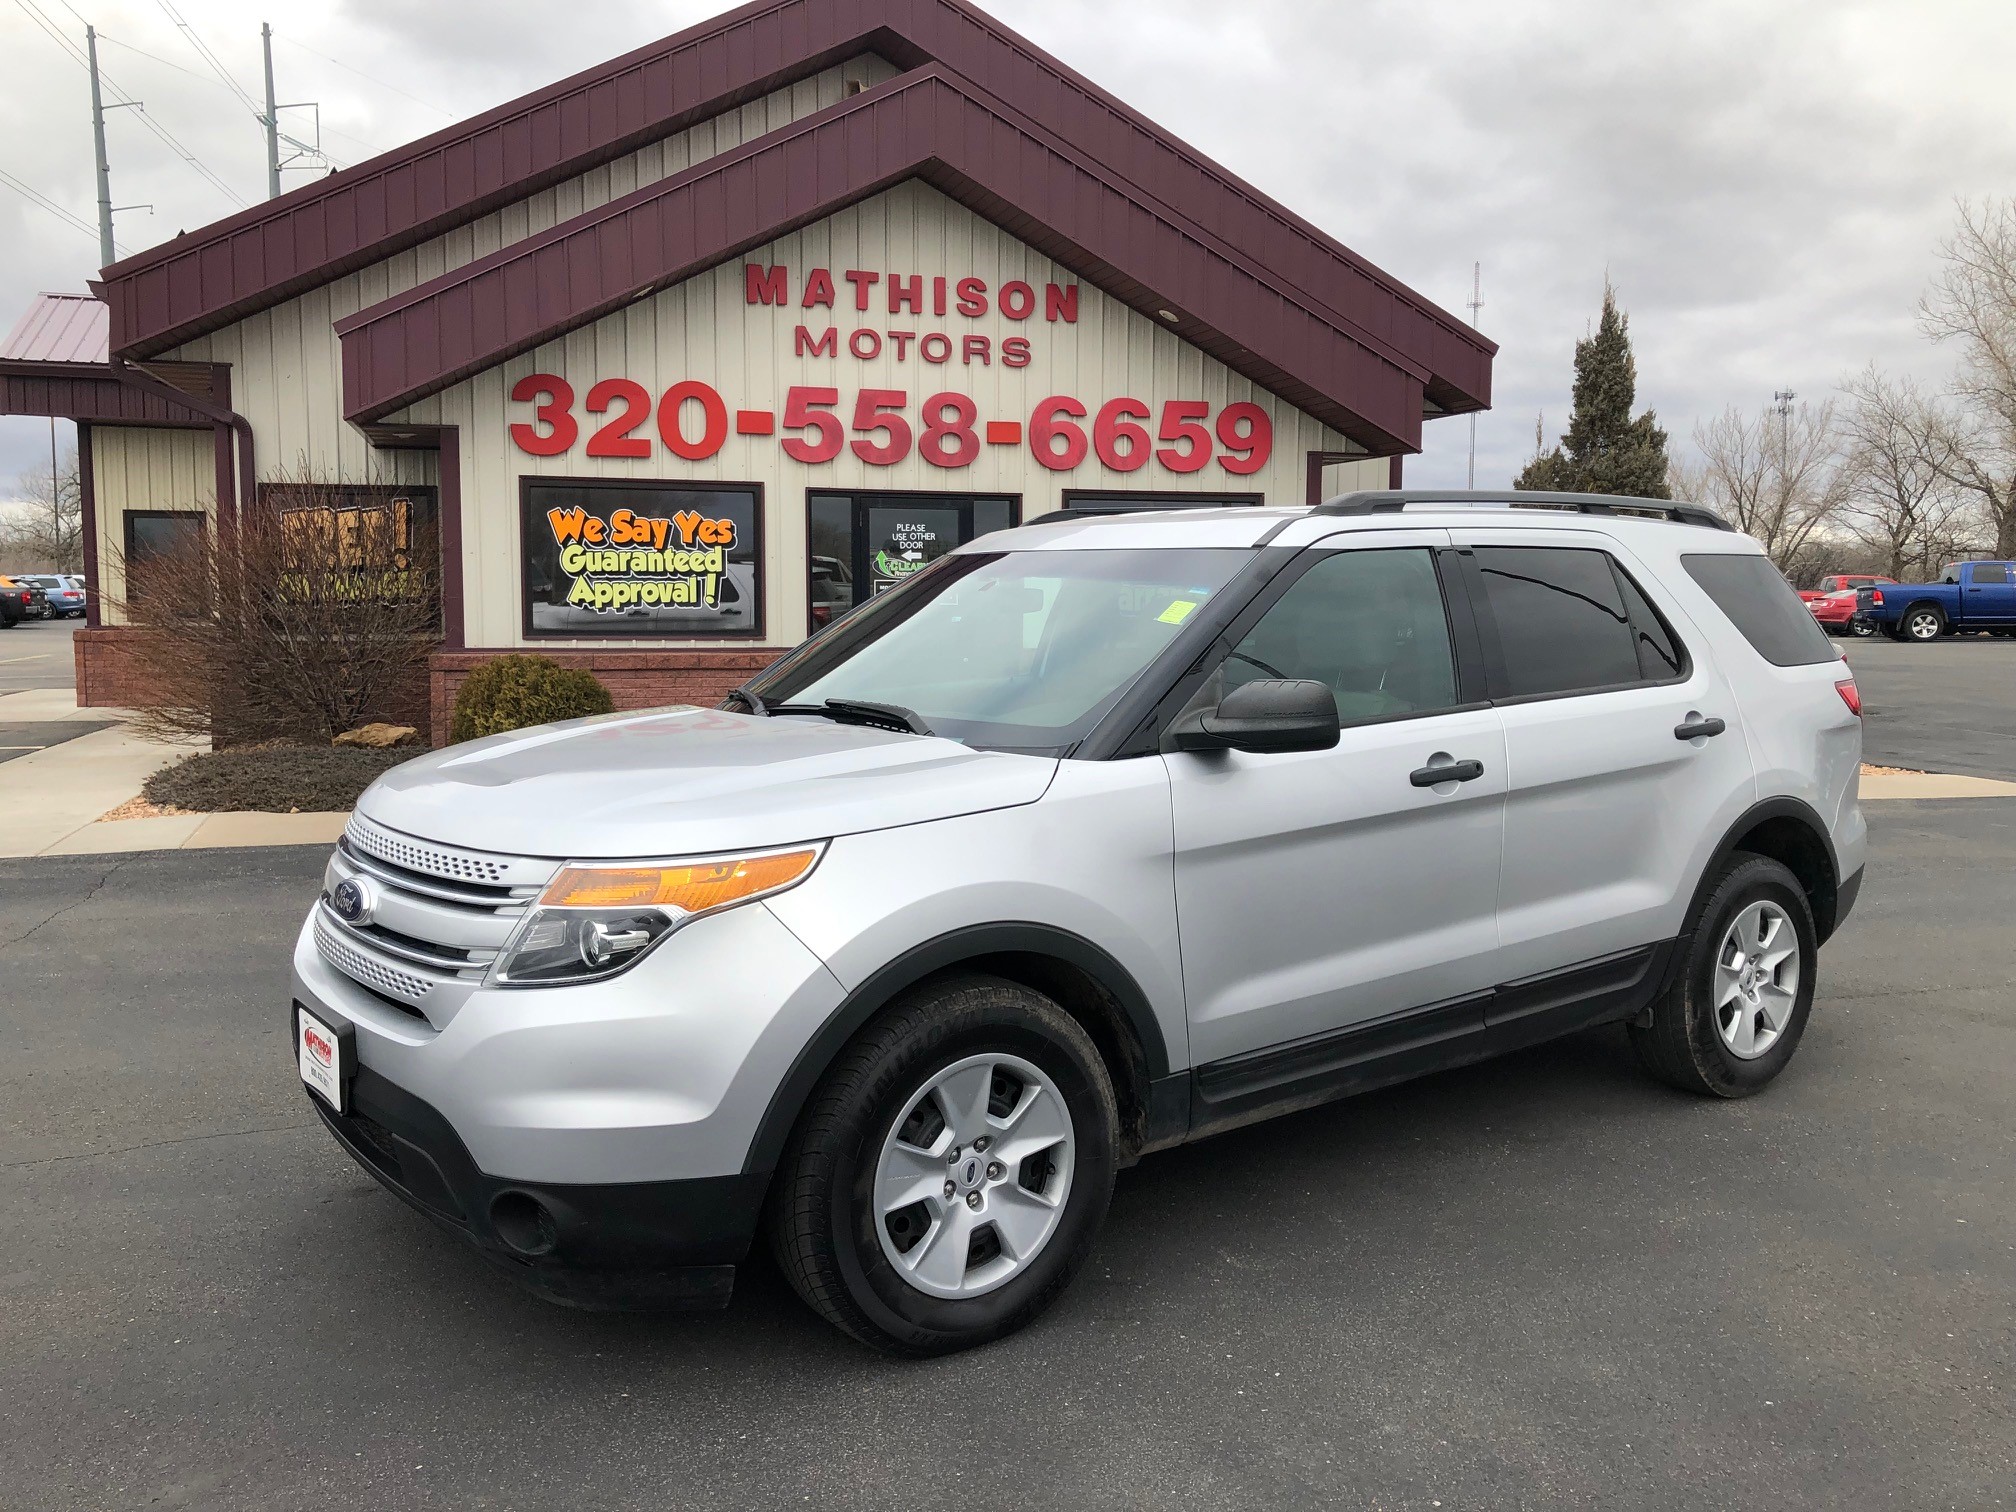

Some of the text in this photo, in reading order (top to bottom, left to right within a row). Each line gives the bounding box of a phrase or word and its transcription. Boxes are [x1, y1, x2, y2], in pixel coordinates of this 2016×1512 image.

[746, 263, 1078, 323] MATHISON
[795, 325, 1031, 368] MOTORS
[510, 373, 1273, 475] 320-558-6659
[548, 506, 735, 550] We Say Yes
[892, 532, 936, 541] USE OTHER
[896, 523, 926, 532] PLEASE
[561, 544, 724, 575] Guaranteed
[899, 541, 924, 549] DOOR
[336, 884, 357, 913] Ford
